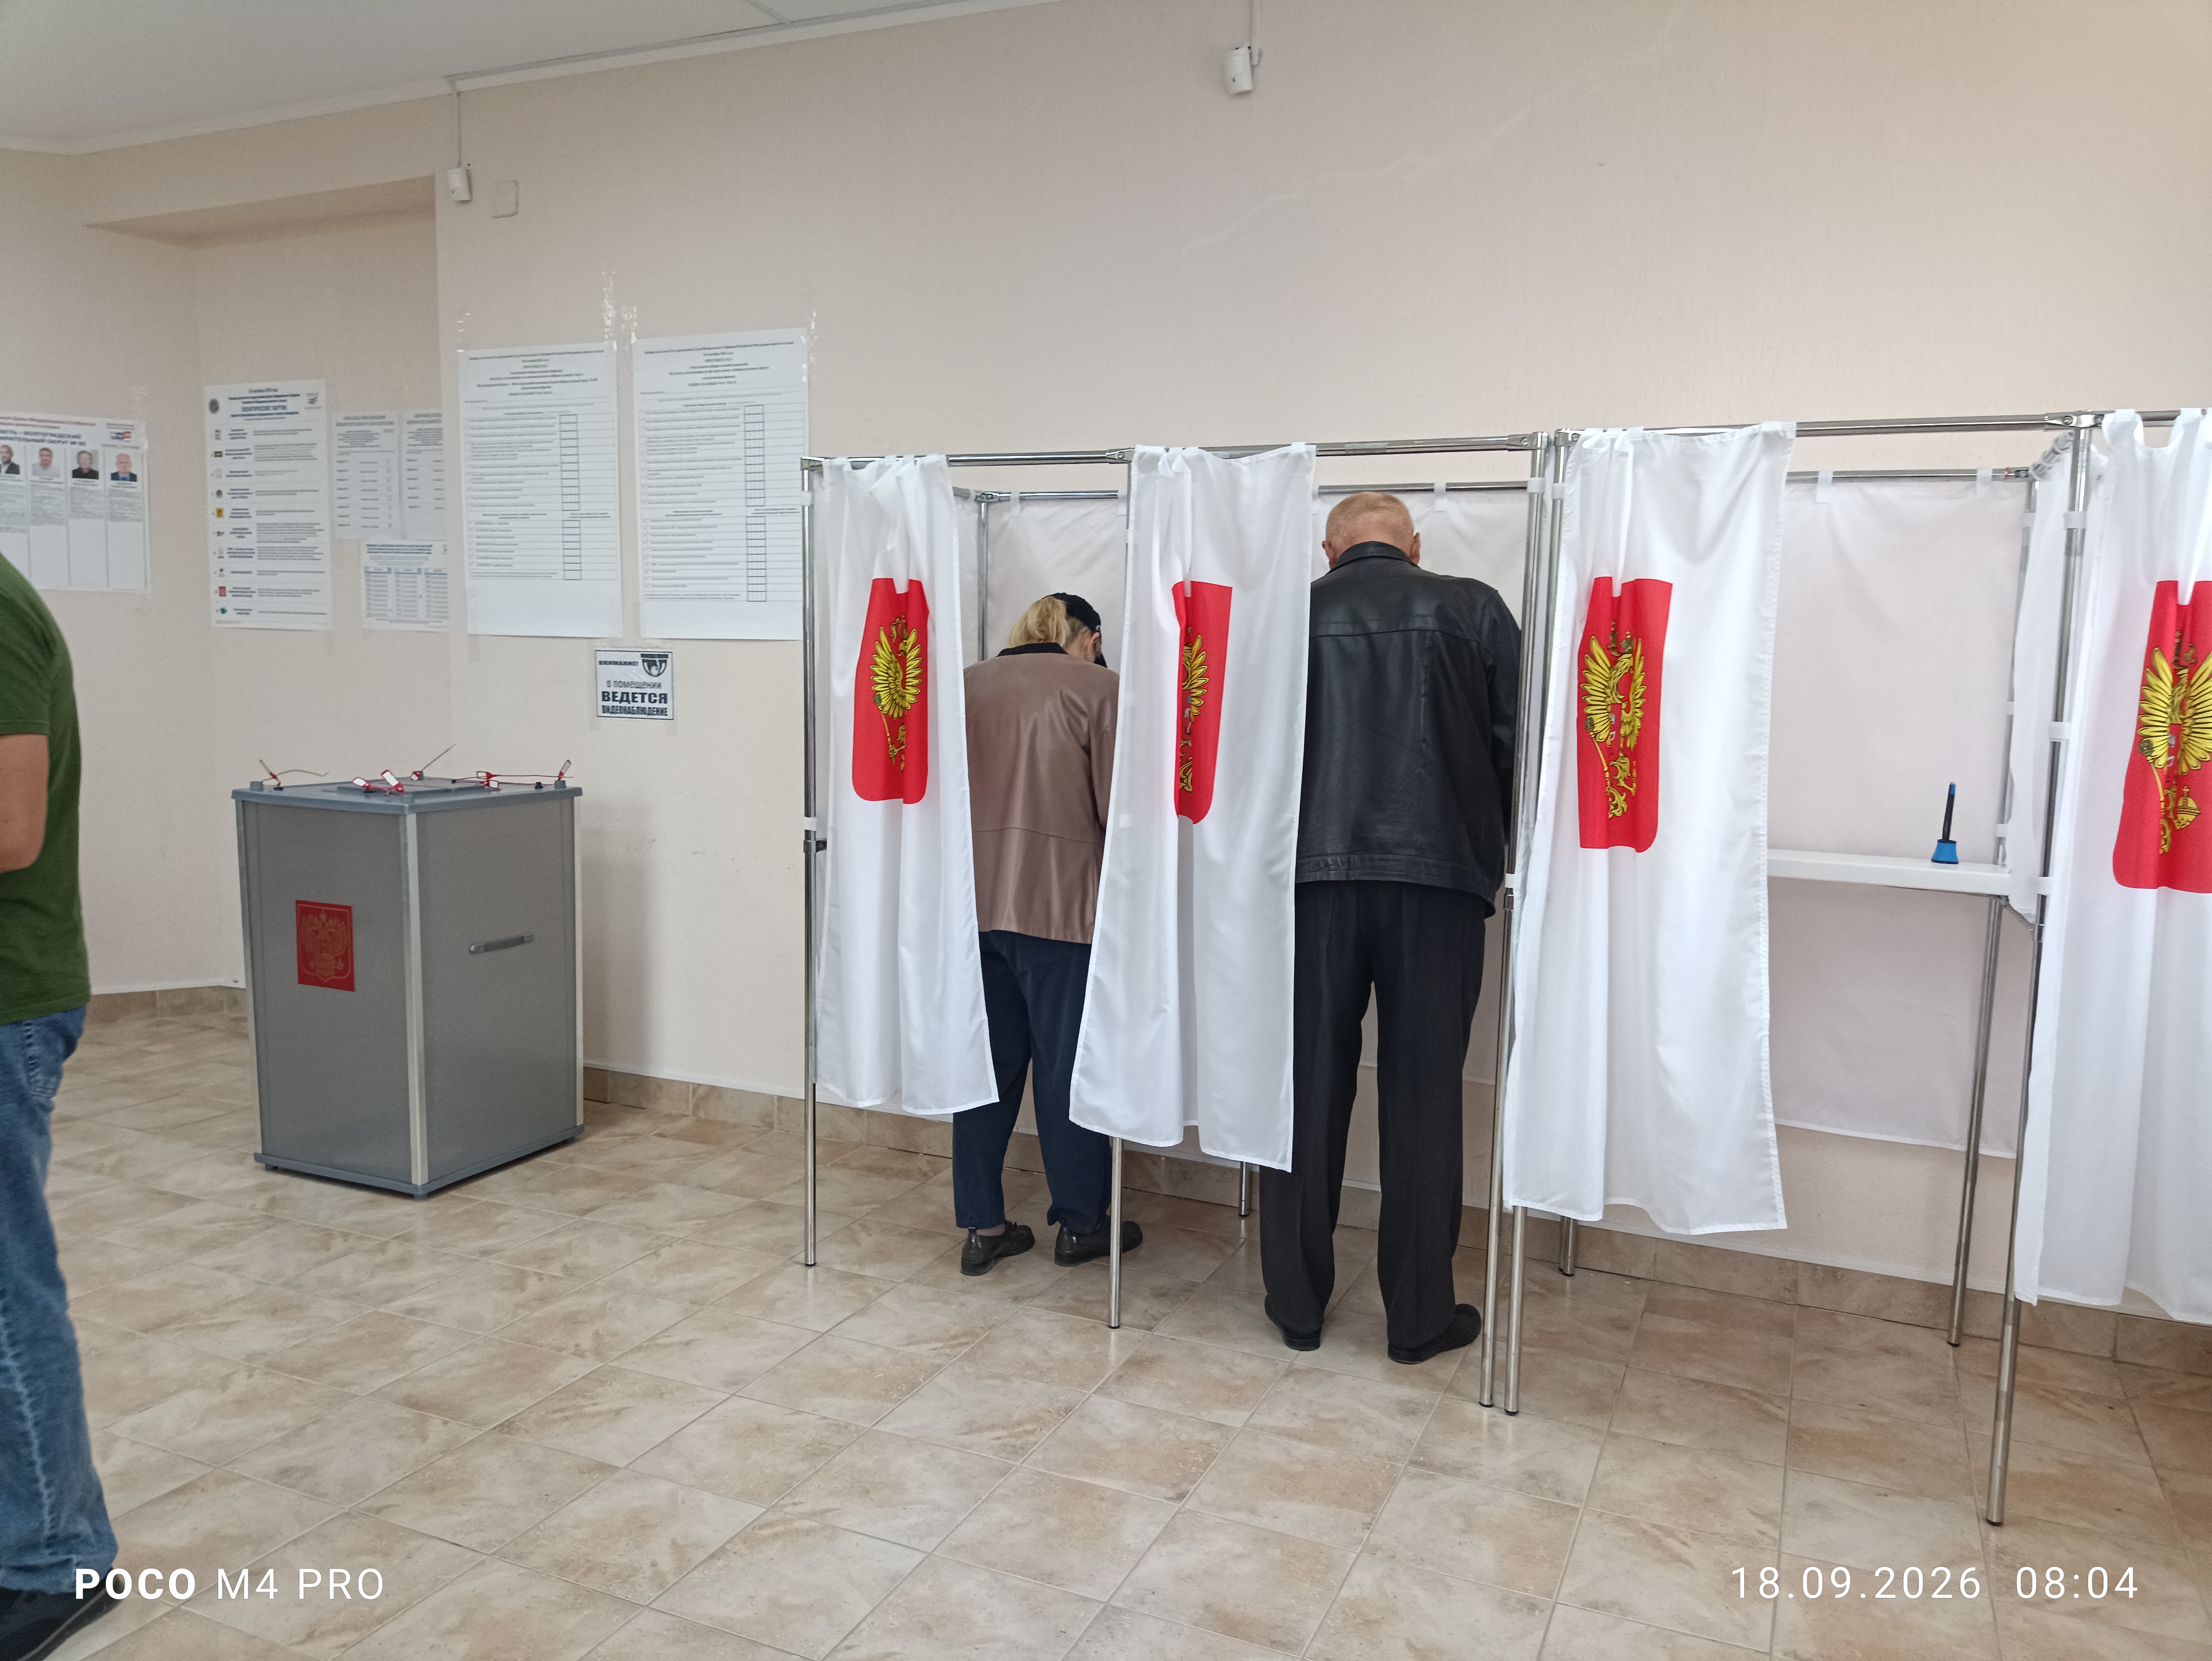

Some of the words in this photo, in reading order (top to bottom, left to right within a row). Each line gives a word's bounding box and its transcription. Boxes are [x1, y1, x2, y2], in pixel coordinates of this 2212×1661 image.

[613, 681, 662, 689] ПОМЕЩЕНИИ
[602, 691, 667, 704] ВЕДЕТСЯ
[602, 705, 668, 716] ВИДЕОНАБЛЮДЕНИЕ
